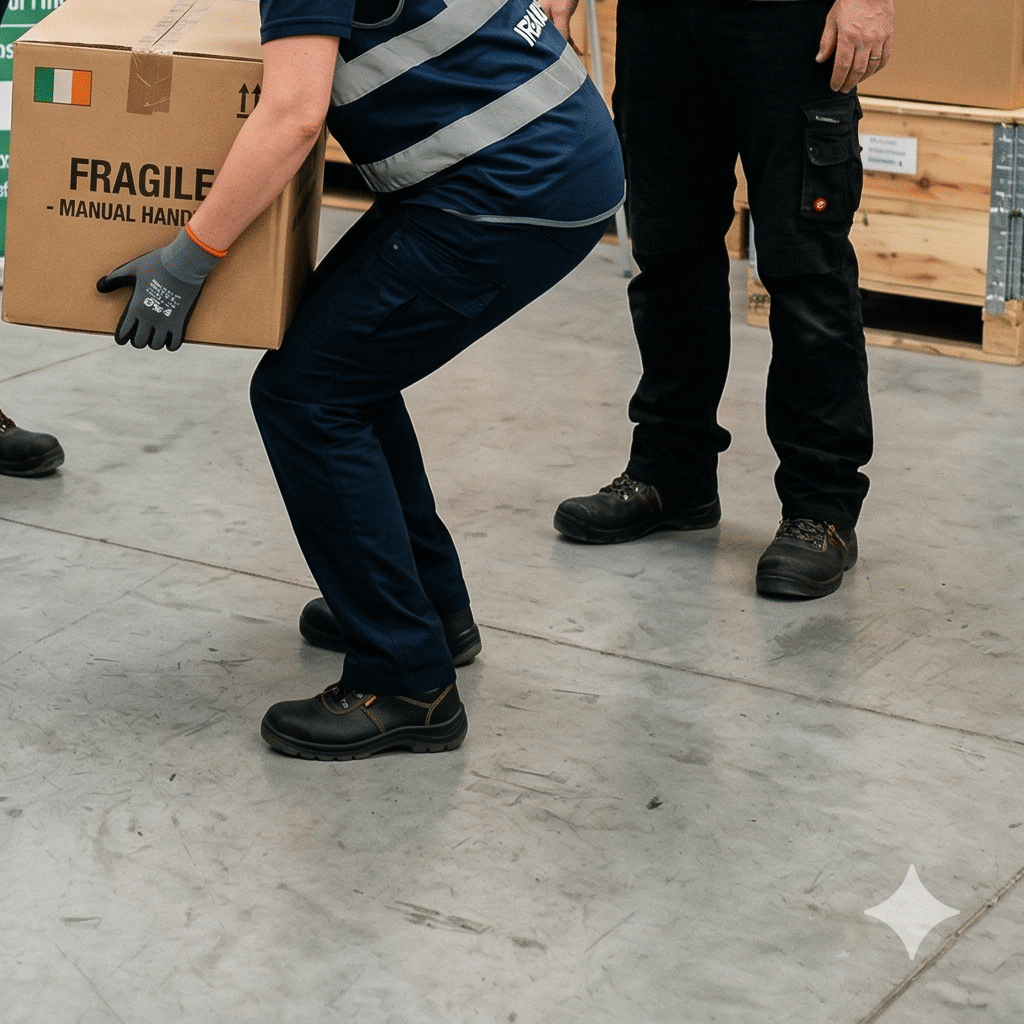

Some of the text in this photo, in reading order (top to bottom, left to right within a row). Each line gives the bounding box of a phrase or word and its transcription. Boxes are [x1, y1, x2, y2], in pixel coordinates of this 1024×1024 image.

[69, 157, 216, 202] FRAGILE
[59, 198, 136, 223] MANUAL
[141, 205, 197, 227] HAND
